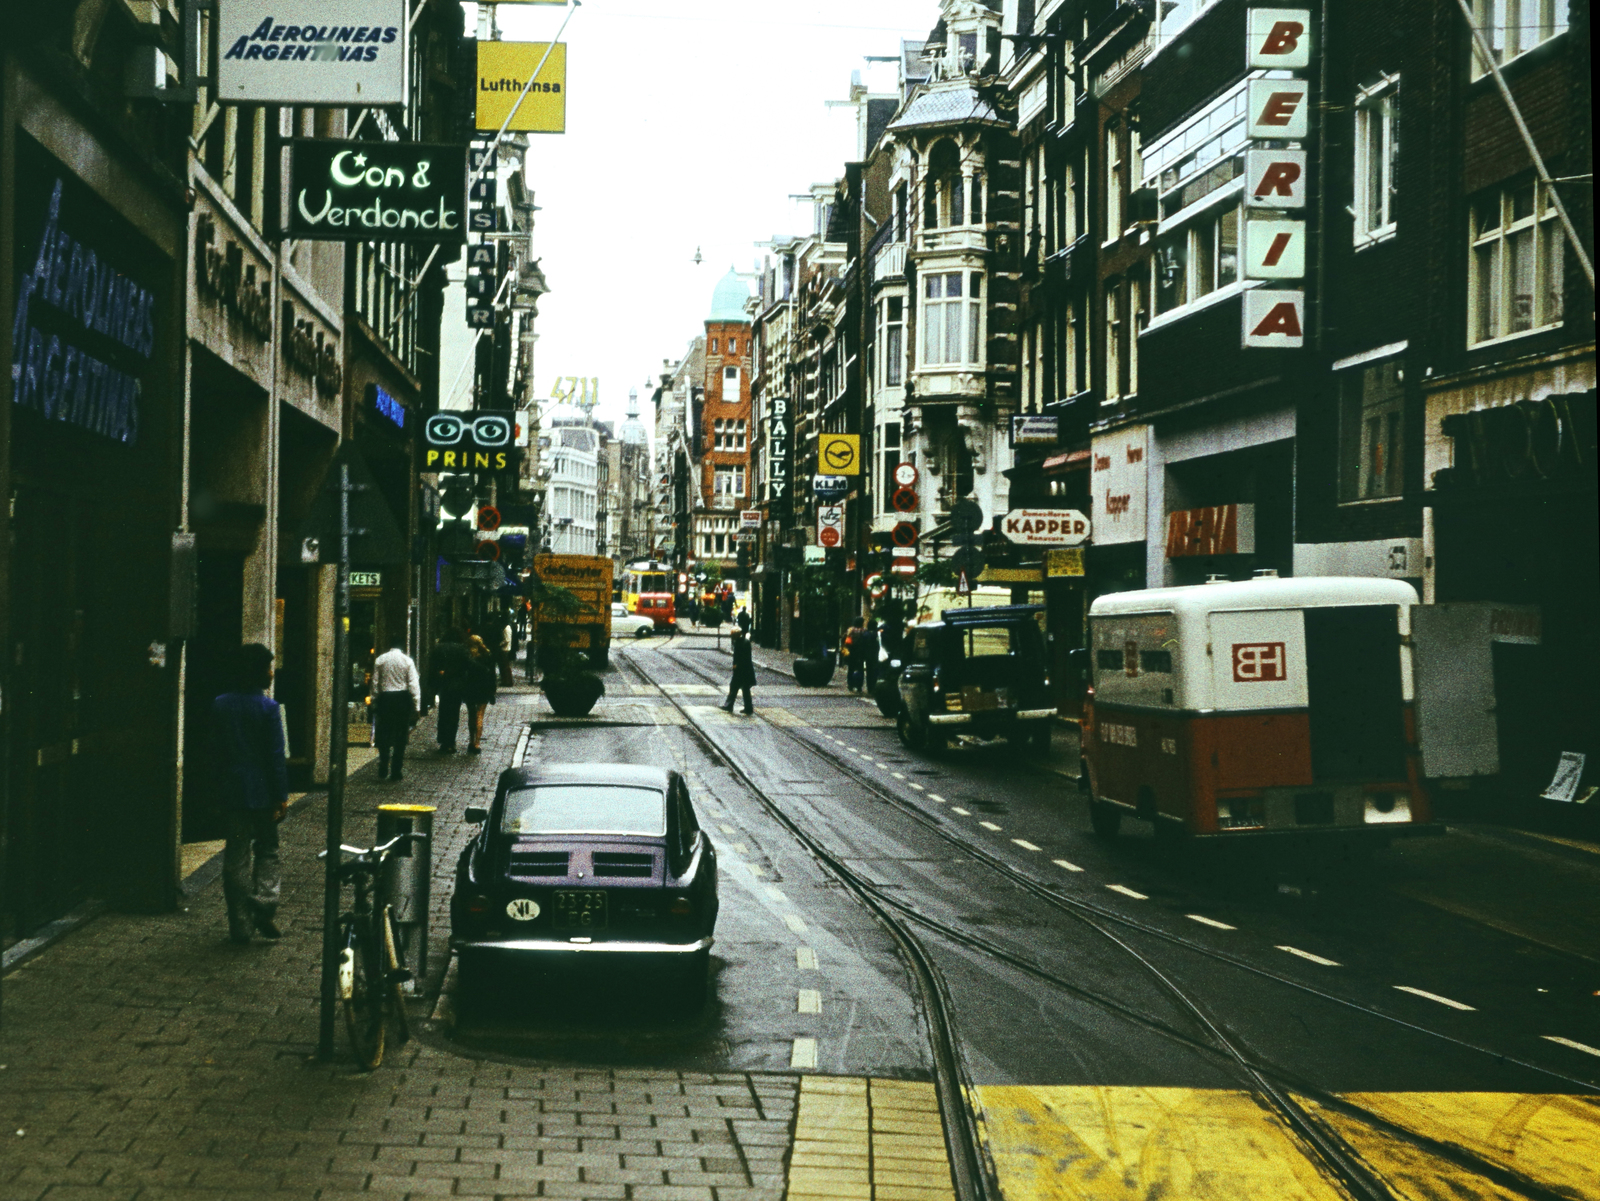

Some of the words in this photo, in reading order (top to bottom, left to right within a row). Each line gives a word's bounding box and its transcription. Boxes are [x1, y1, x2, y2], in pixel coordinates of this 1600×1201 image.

[249, 16, 398, 43] AEROLINEAS
[480, 77, 561, 93] Lufthansa
[330, 150, 405, 188] Con
[412, 161, 431, 188] &
[1250, 21, 1304, 337] BERIA
[298, 188, 459, 230] Verdonck
[550, 376, 599, 405] 4711
[427, 450, 507, 470] PRINS
[772, 400, 787, 498] BALLY
[815, 480, 847, 490] KLM
[1007, 519, 1085, 534] KAPPER
